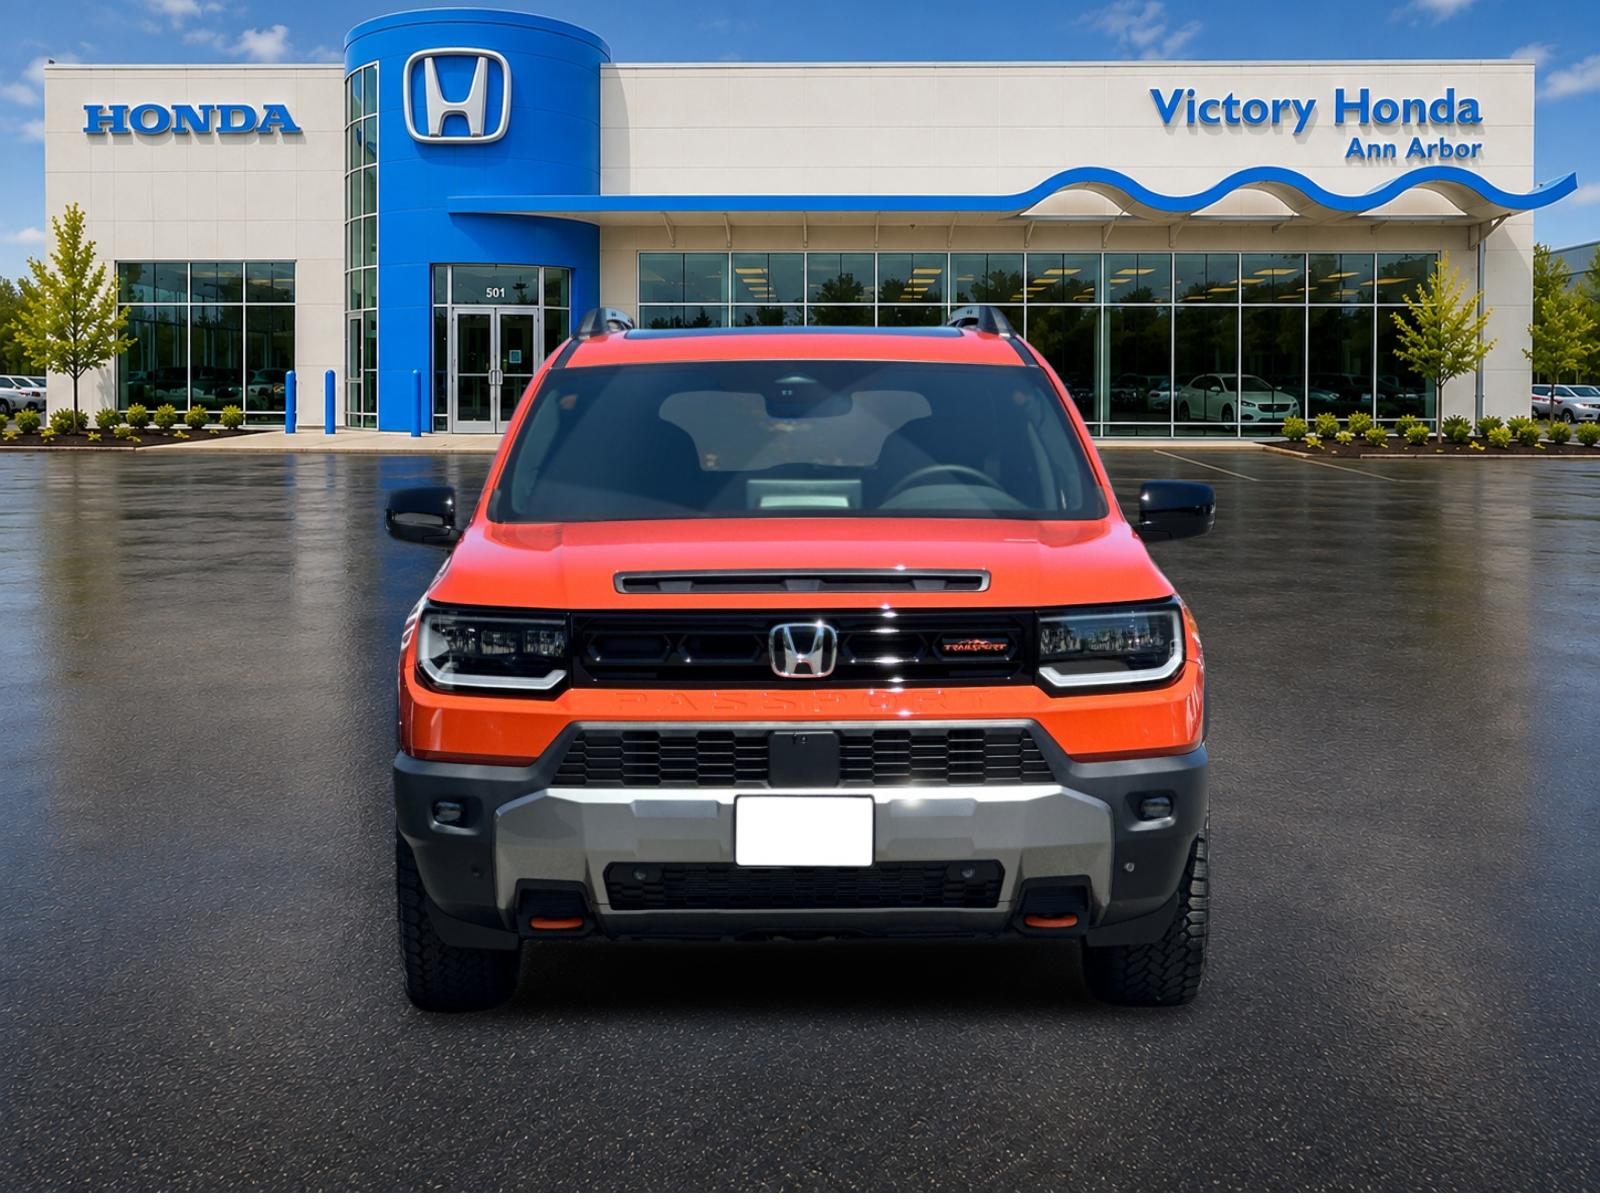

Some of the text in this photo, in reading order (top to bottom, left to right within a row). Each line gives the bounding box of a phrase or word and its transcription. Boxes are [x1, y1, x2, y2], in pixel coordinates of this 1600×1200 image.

[83, 103, 303, 136] HONDA
[1150, 87, 1484, 135] Victory Honda
[1345, 136, 1483, 160] Ann Arbor
[485, 287, 505, 299] 501
[615, 690, 992, 714] PASSPORT
